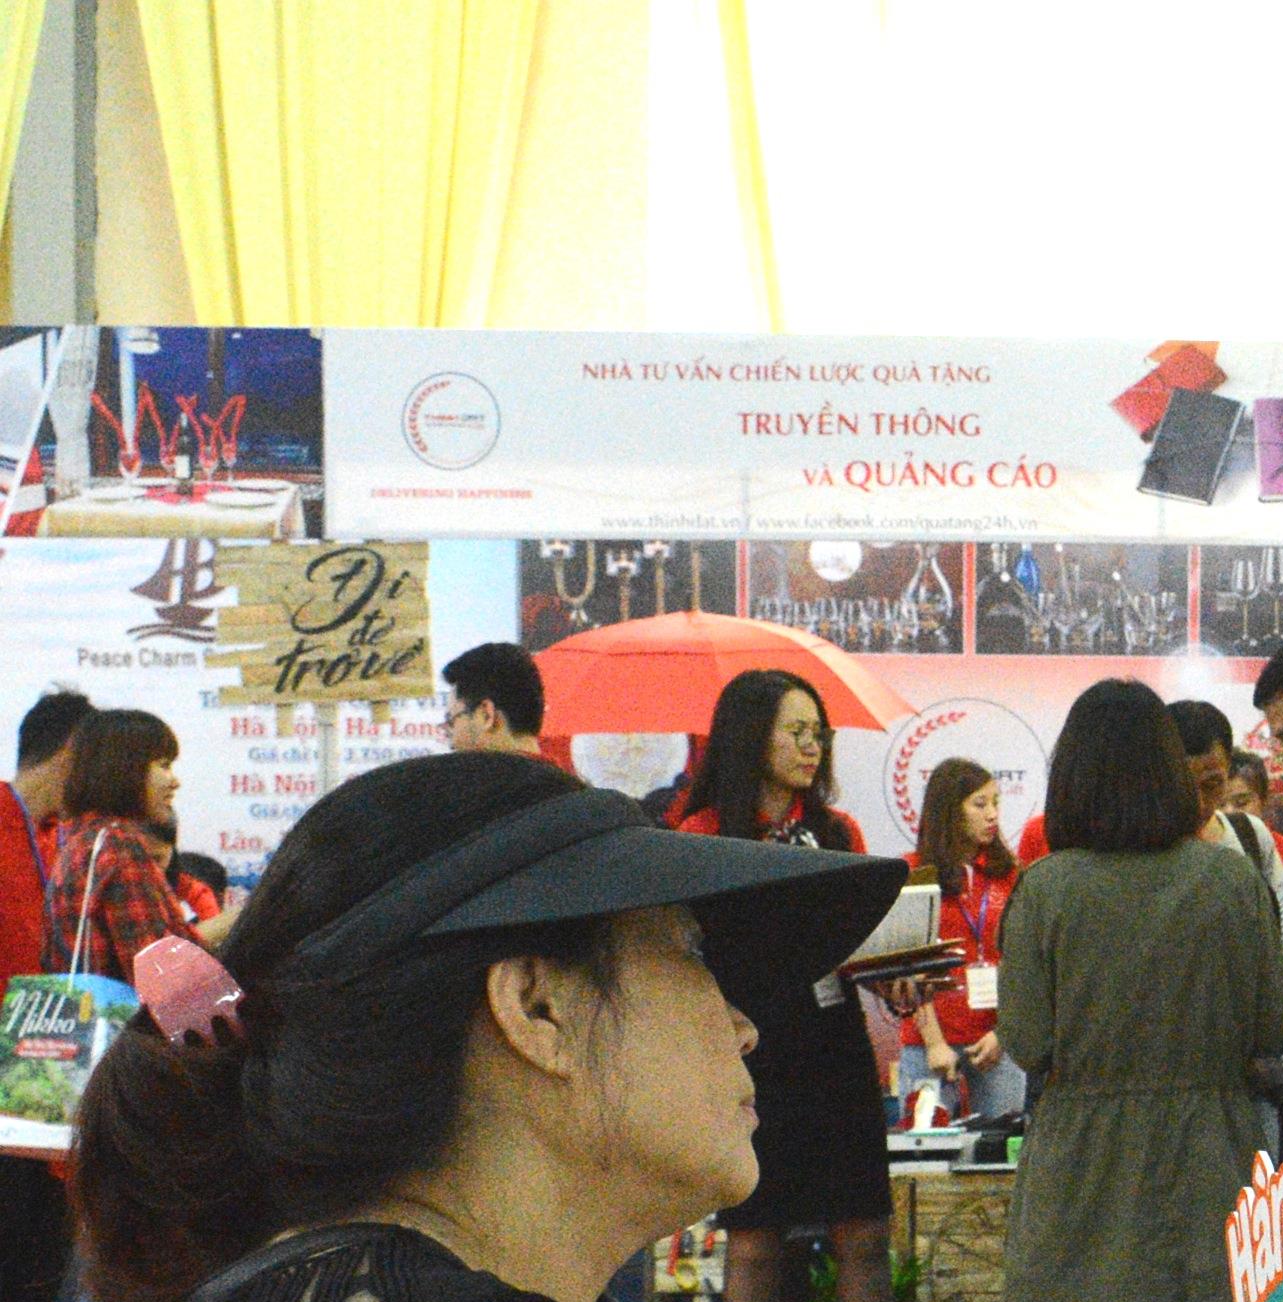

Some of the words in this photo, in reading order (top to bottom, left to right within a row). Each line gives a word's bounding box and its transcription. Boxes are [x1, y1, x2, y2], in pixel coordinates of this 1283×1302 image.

[583, 358, 632, 380] NHÀ
[641, 361, 670, 381] TƯ
[676, 357, 721, 381] VẤN
[729, 356, 799, 382] CHIẾN
[809, 362, 864, 386] LƯỢC
[872, 360, 920, 385] QUÀ
[929, 364, 991, 387] TẶNG
[738, 402, 859, 436] TRUYỀN
[872, 408, 981, 437] THÔNG
[844, 452, 976, 492] QUẢNG
[987, 454, 1057, 488] CÁO
[78, 648, 134, 668] Peace
[138, 648, 196, 668] Charm
[230, 716, 265, 737] Hà
[230, 774, 265, 794] Hà
[275, 774, 316, 797] Nội
